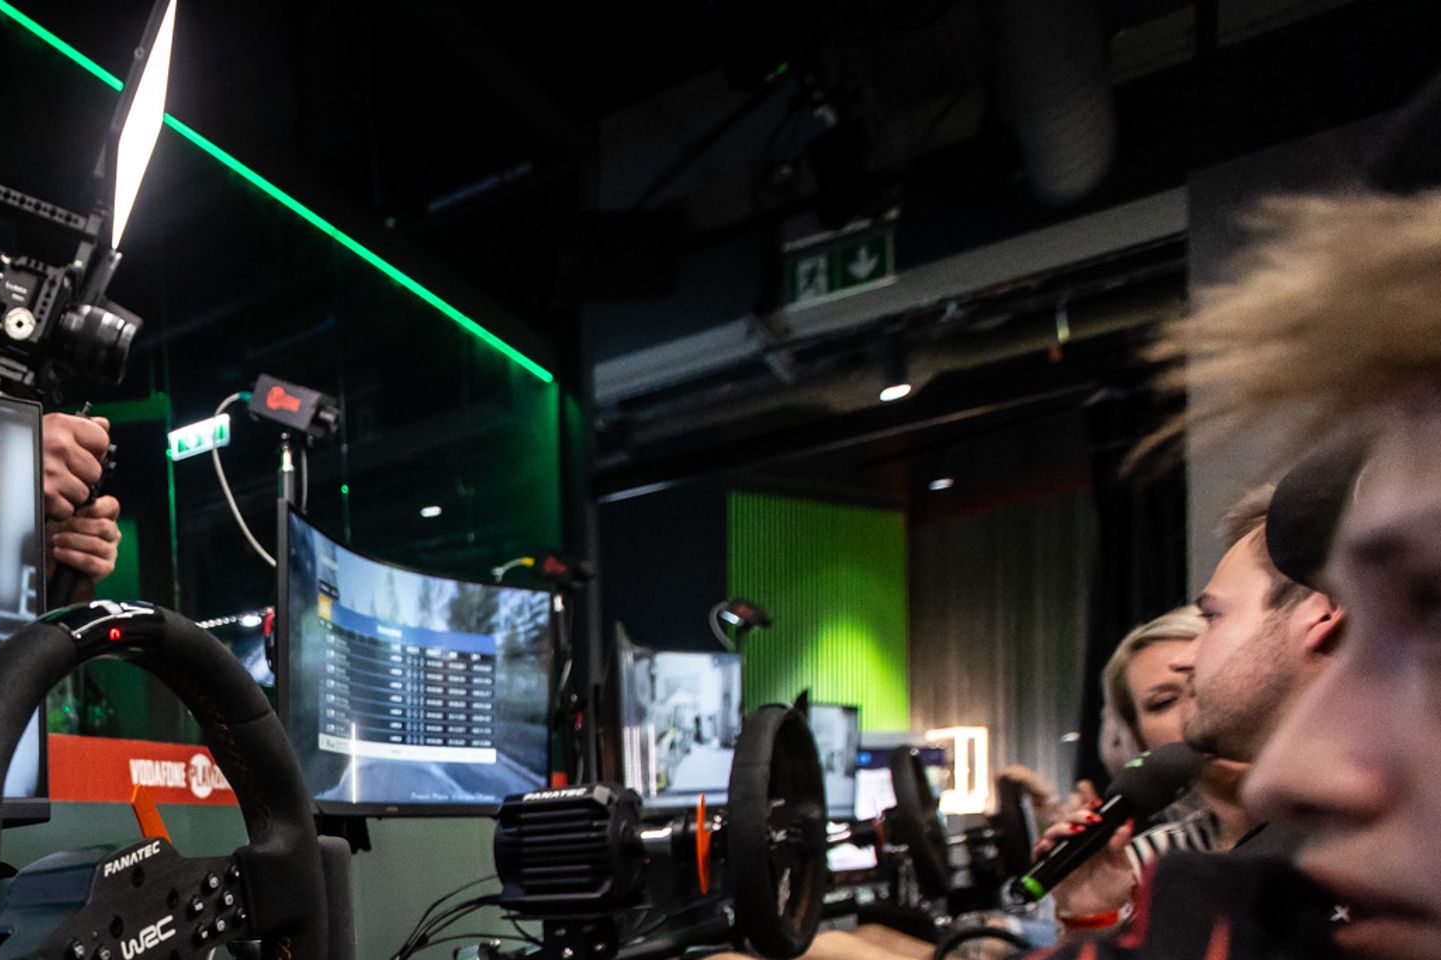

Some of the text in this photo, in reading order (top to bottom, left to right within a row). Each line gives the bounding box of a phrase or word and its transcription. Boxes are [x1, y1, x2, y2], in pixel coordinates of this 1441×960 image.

[129, 759, 186, 788] VODAFONE
[524, 787, 587, 802] FANATEC
[104, 841, 161, 877] FANATEC
